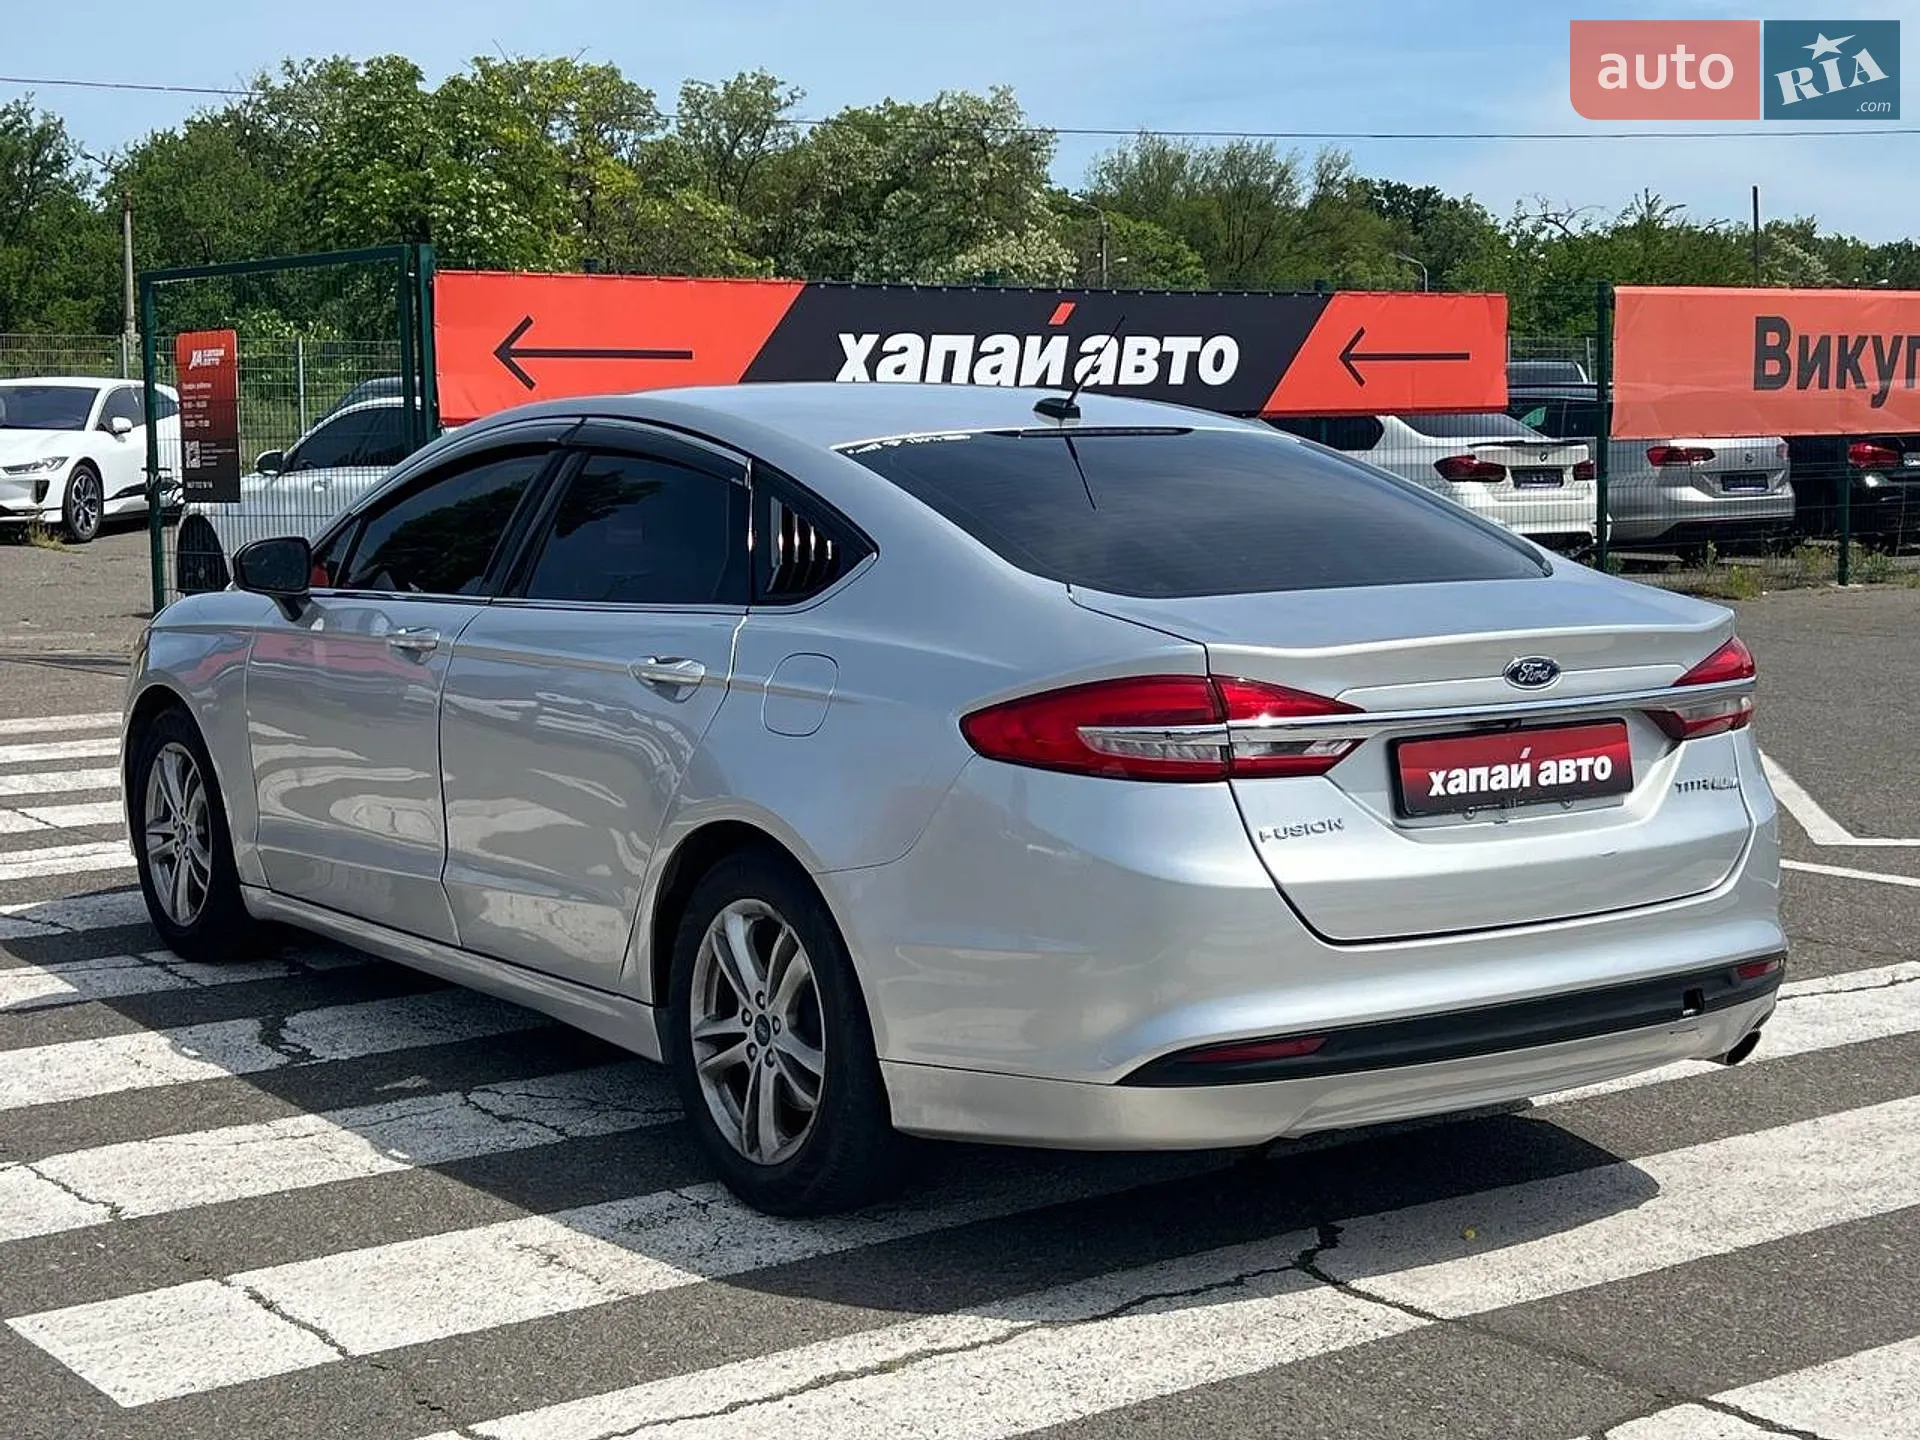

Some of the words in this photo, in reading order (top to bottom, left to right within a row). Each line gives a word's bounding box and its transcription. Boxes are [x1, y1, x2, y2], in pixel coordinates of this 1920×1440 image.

[1428, 747, 1532, 797] хапай
[1537, 755, 1613, 787] авто
[1258, 817, 1345, 844] FUSION
